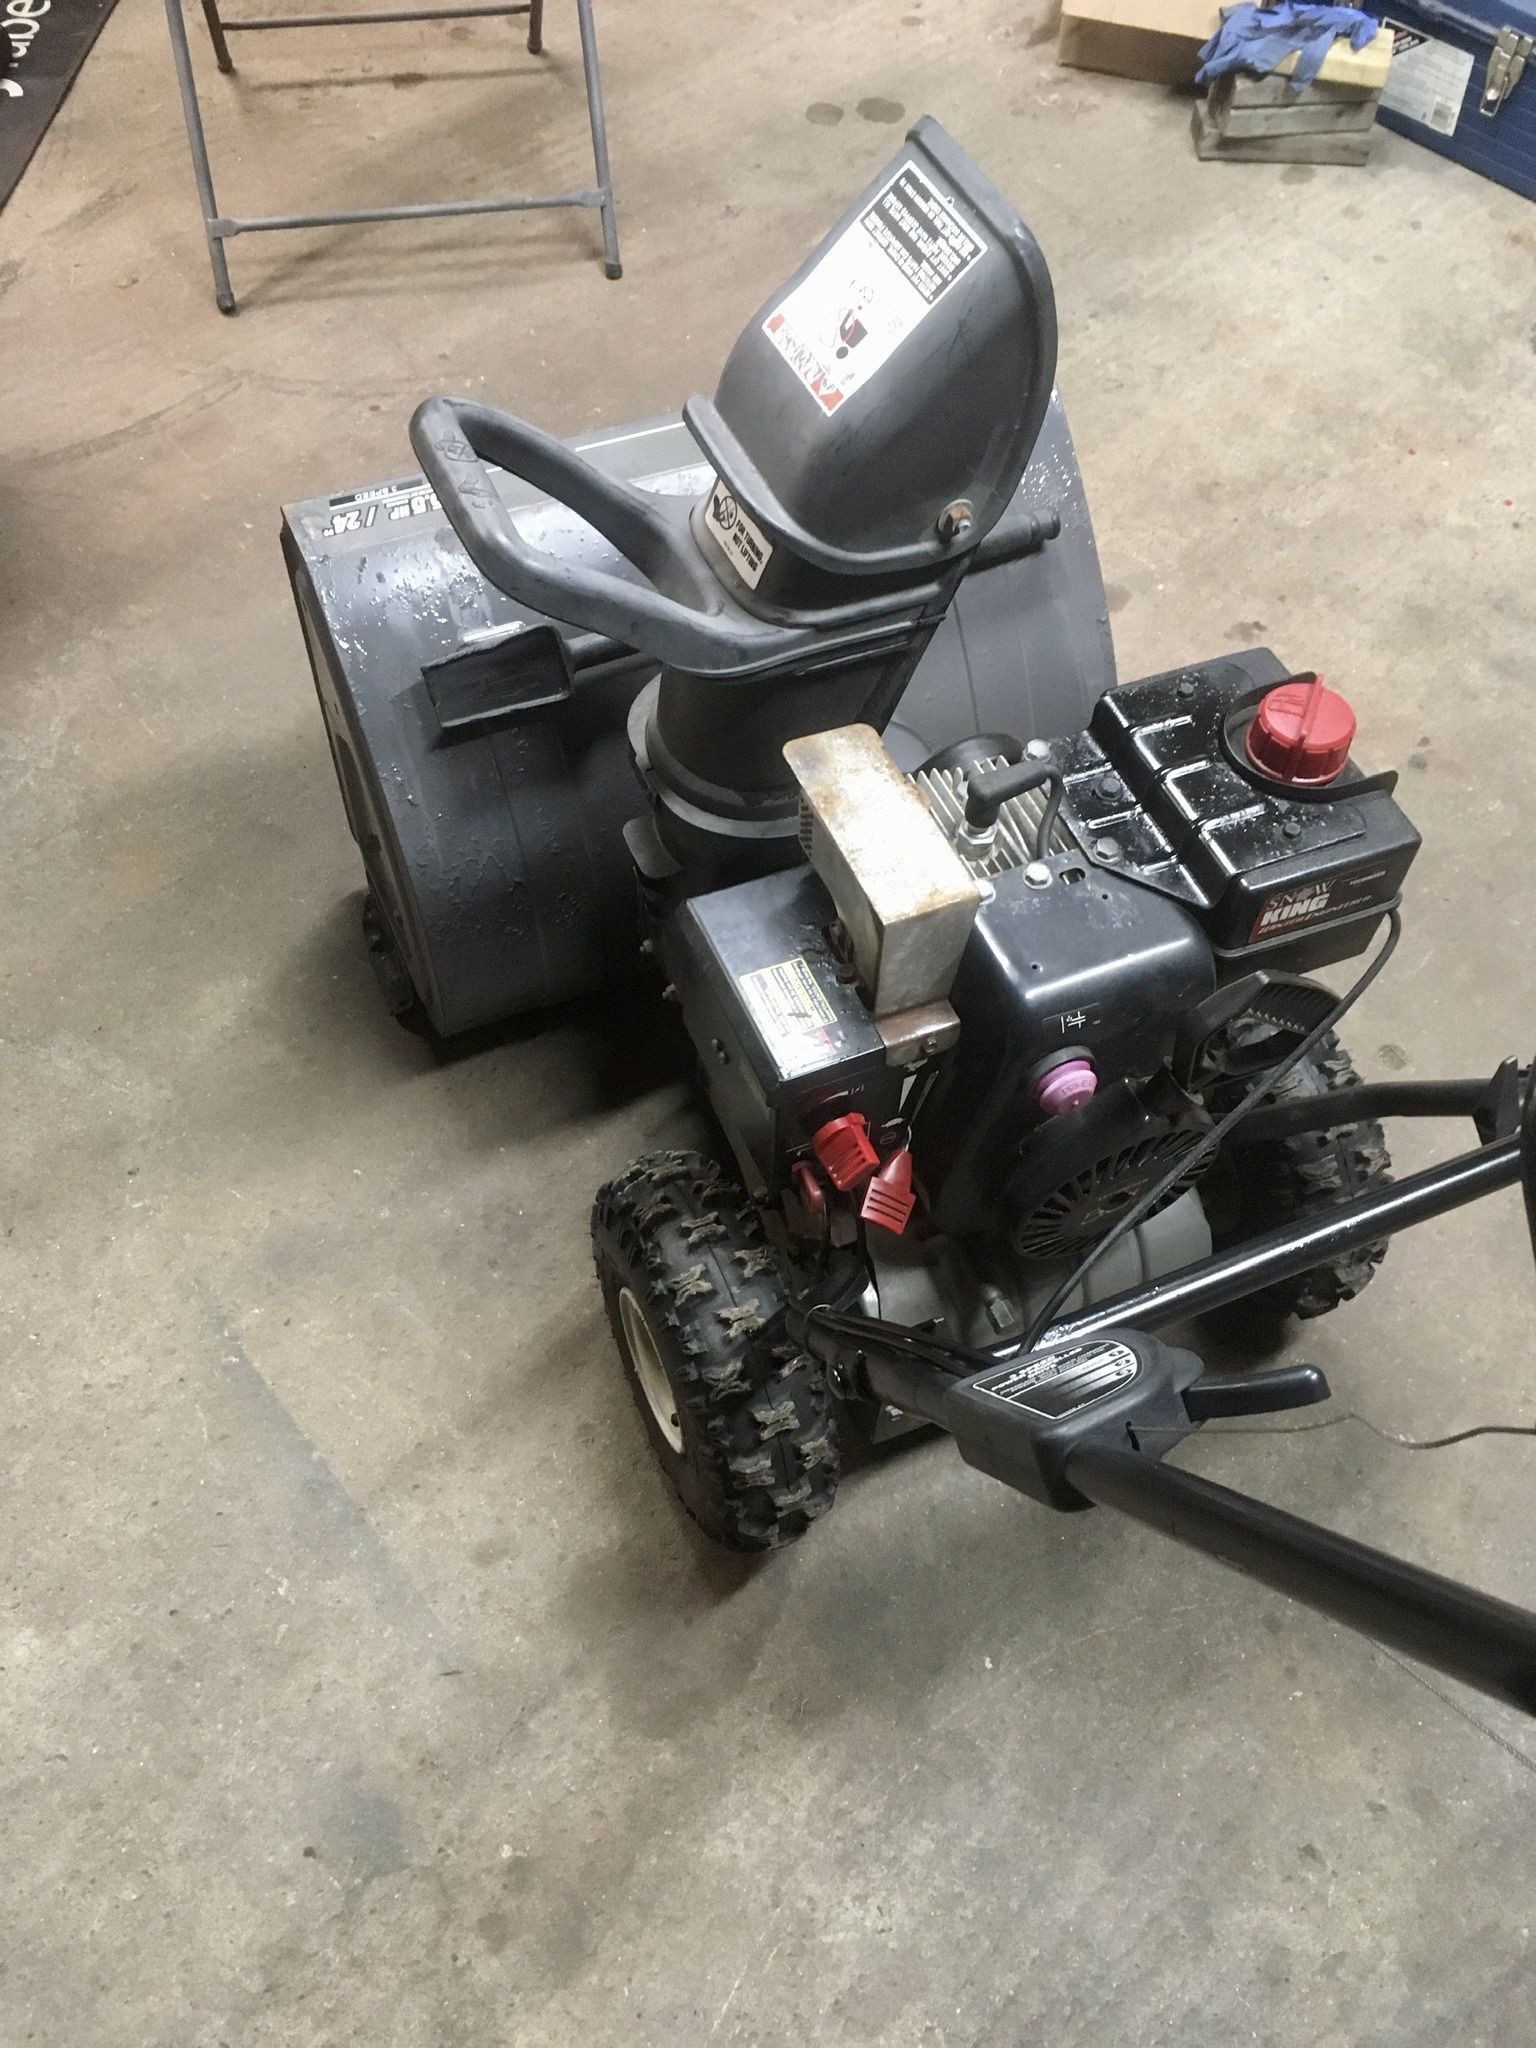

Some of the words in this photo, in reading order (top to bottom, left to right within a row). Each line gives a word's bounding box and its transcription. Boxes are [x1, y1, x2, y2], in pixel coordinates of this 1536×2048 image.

[355, 487, 388, 501] SPEED
[736, 520, 745, 536] FOR
[733, 533, 742, 548] NOT
[741, 545, 758, 572] LIFTING
[1260, 893, 1330, 927] KING
[1266, 880, 1336, 910] SNOW
